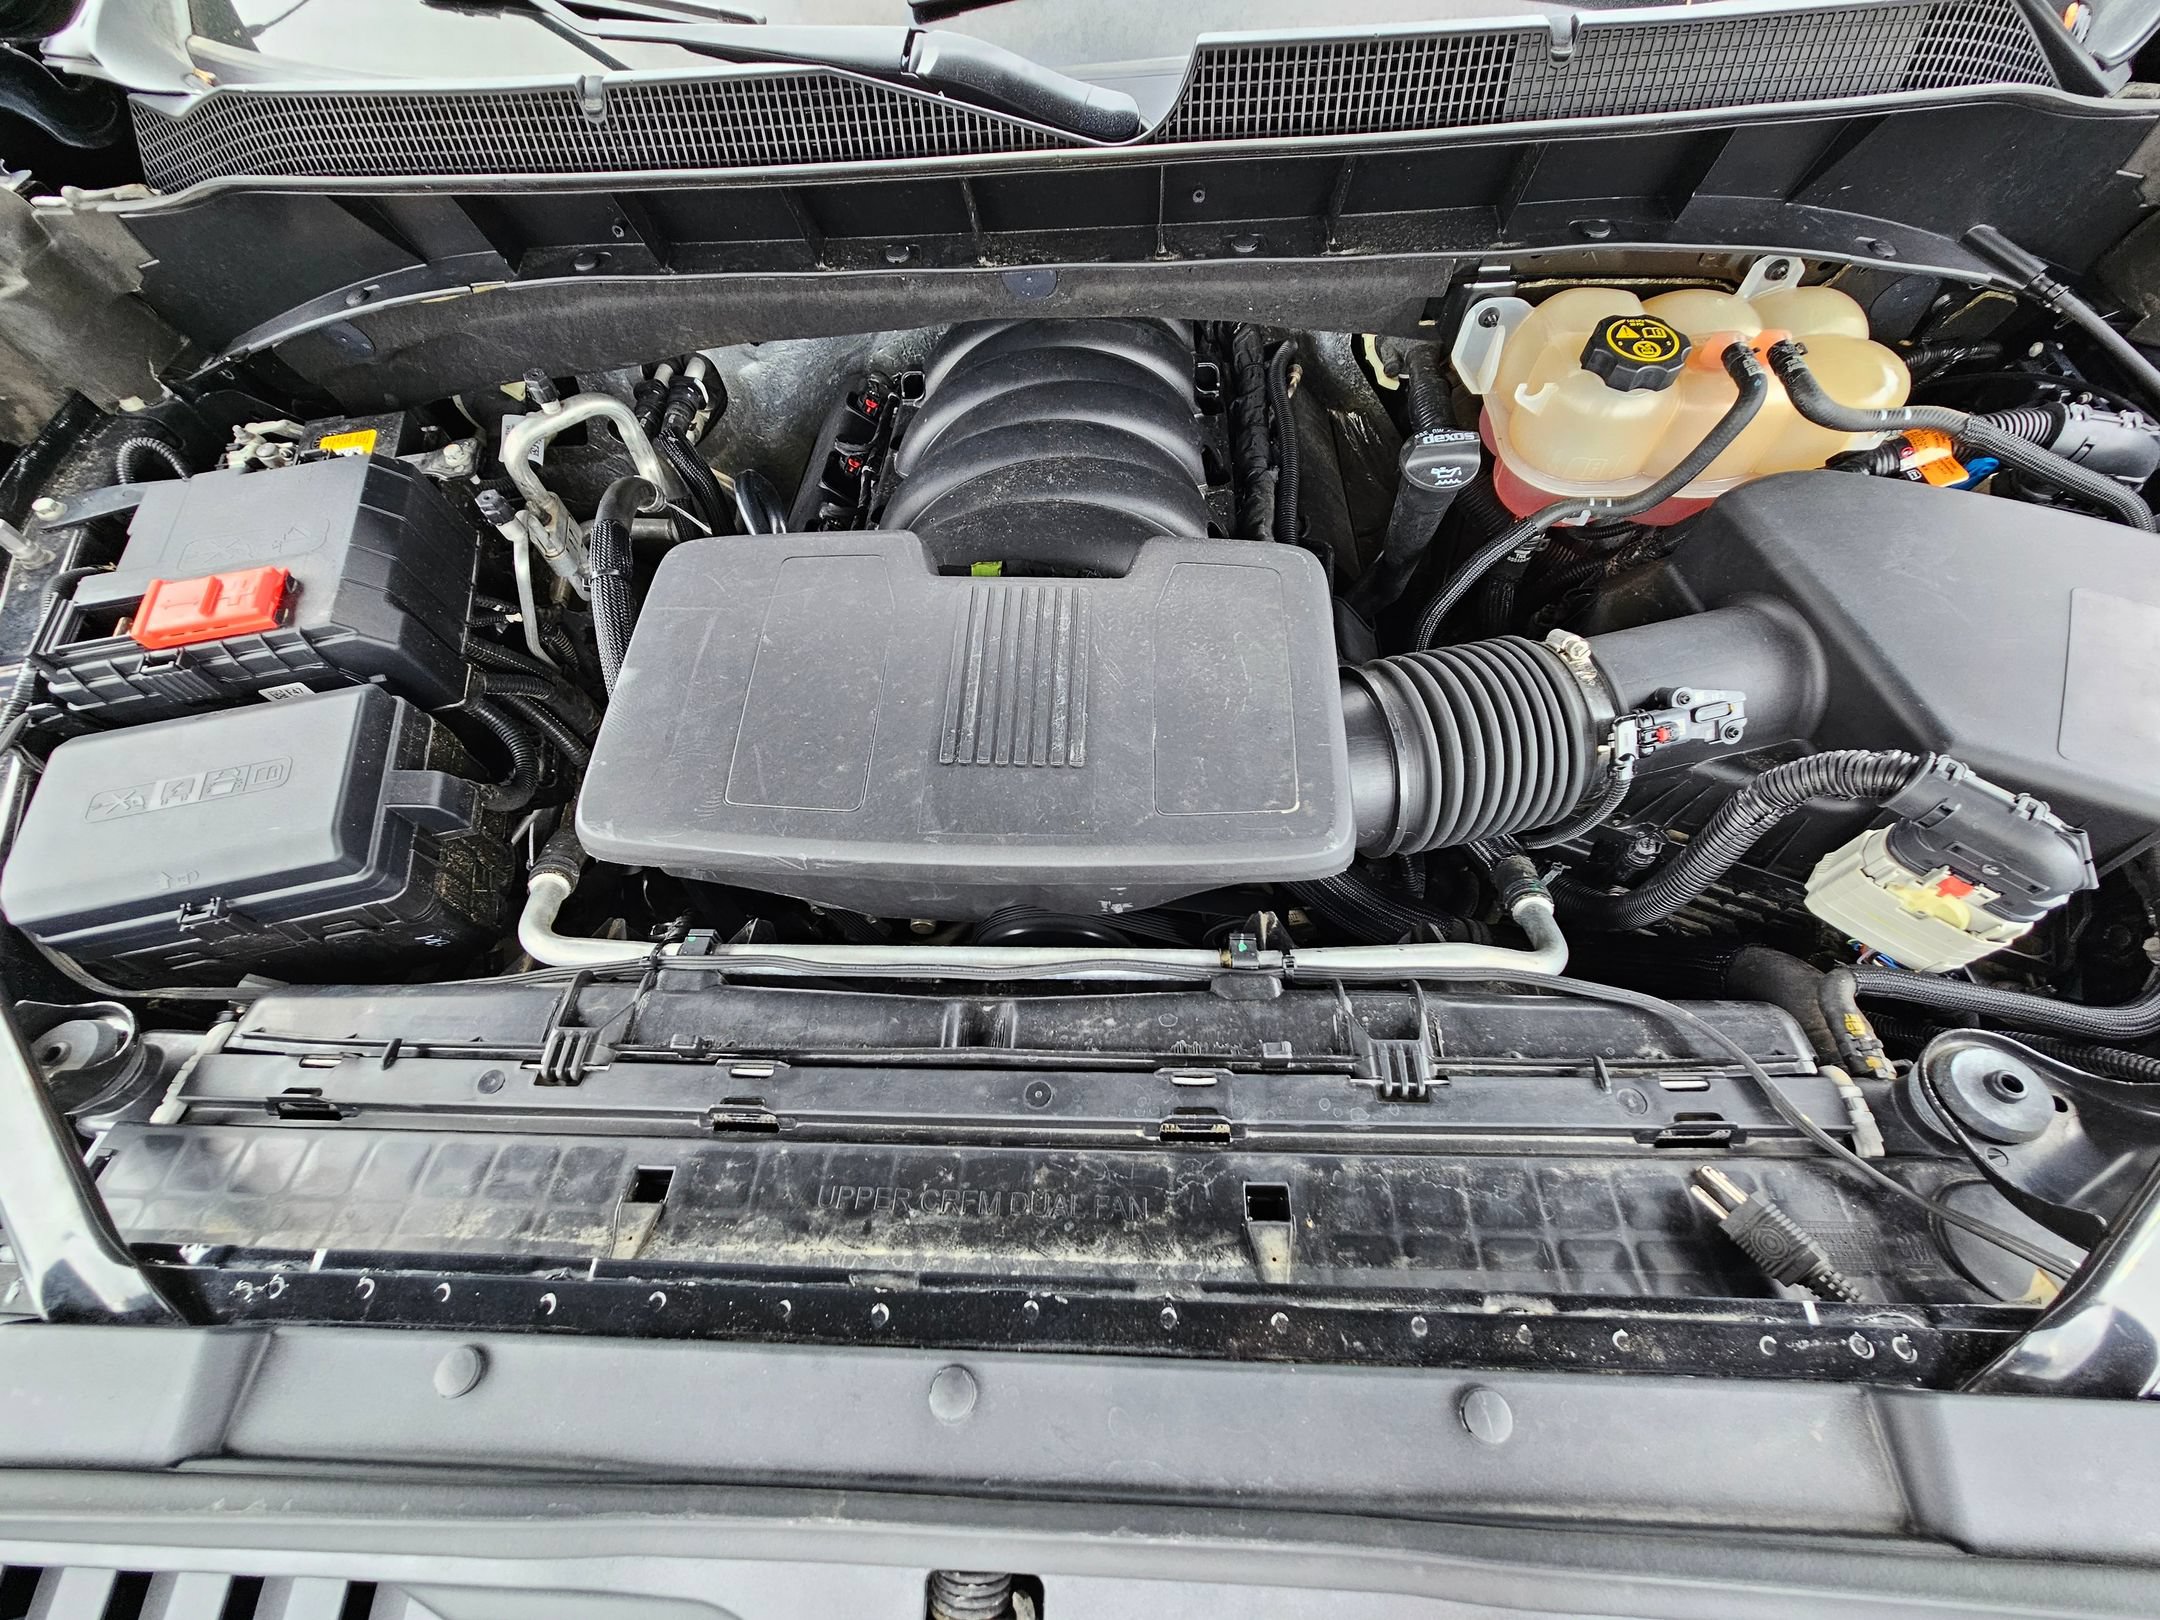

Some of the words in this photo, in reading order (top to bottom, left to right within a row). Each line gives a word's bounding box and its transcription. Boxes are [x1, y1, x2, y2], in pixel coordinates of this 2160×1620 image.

[1422, 432, 1475, 444] dexos
[817, 1185, 912, 1211] UPPER
[1010, 1191, 1081, 1217] DUAL
[1093, 1193, 1148, 1220] FAN
